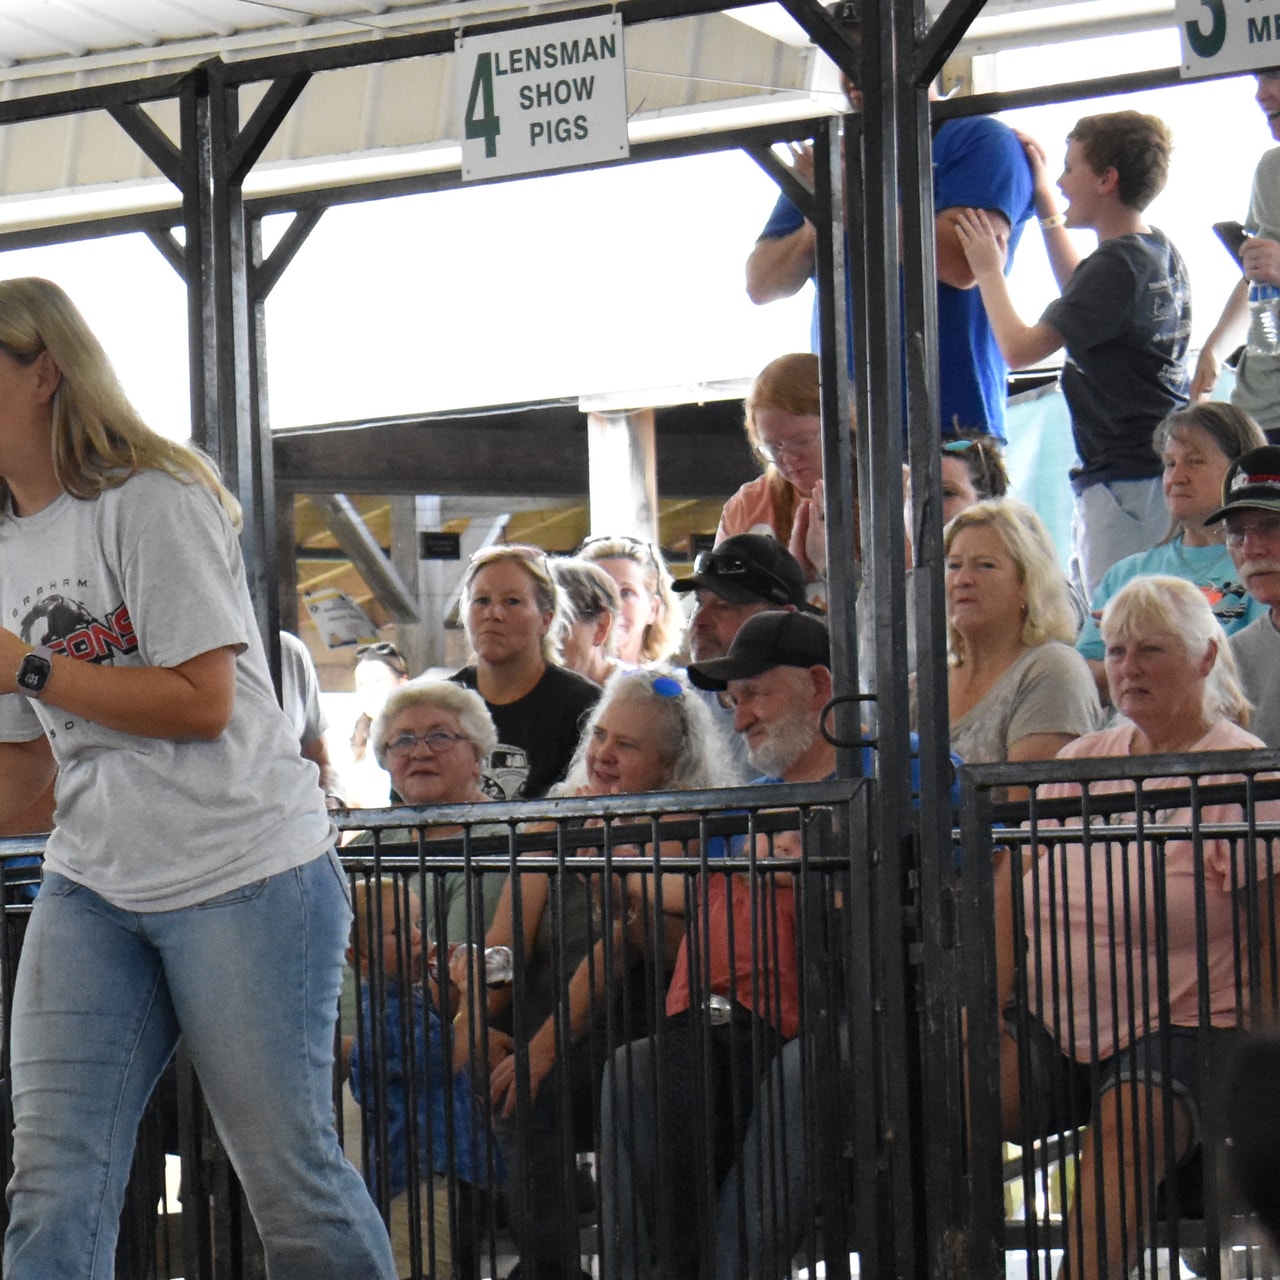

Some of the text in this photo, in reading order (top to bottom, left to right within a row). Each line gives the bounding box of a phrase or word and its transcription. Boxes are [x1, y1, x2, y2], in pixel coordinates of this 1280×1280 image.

[494, 33, 617, 77] LENSMAN
[464, 52, 501, 159] 4
[519, 75, 595, 110] SHOW
[530, 115, 589, 147] PIGS
